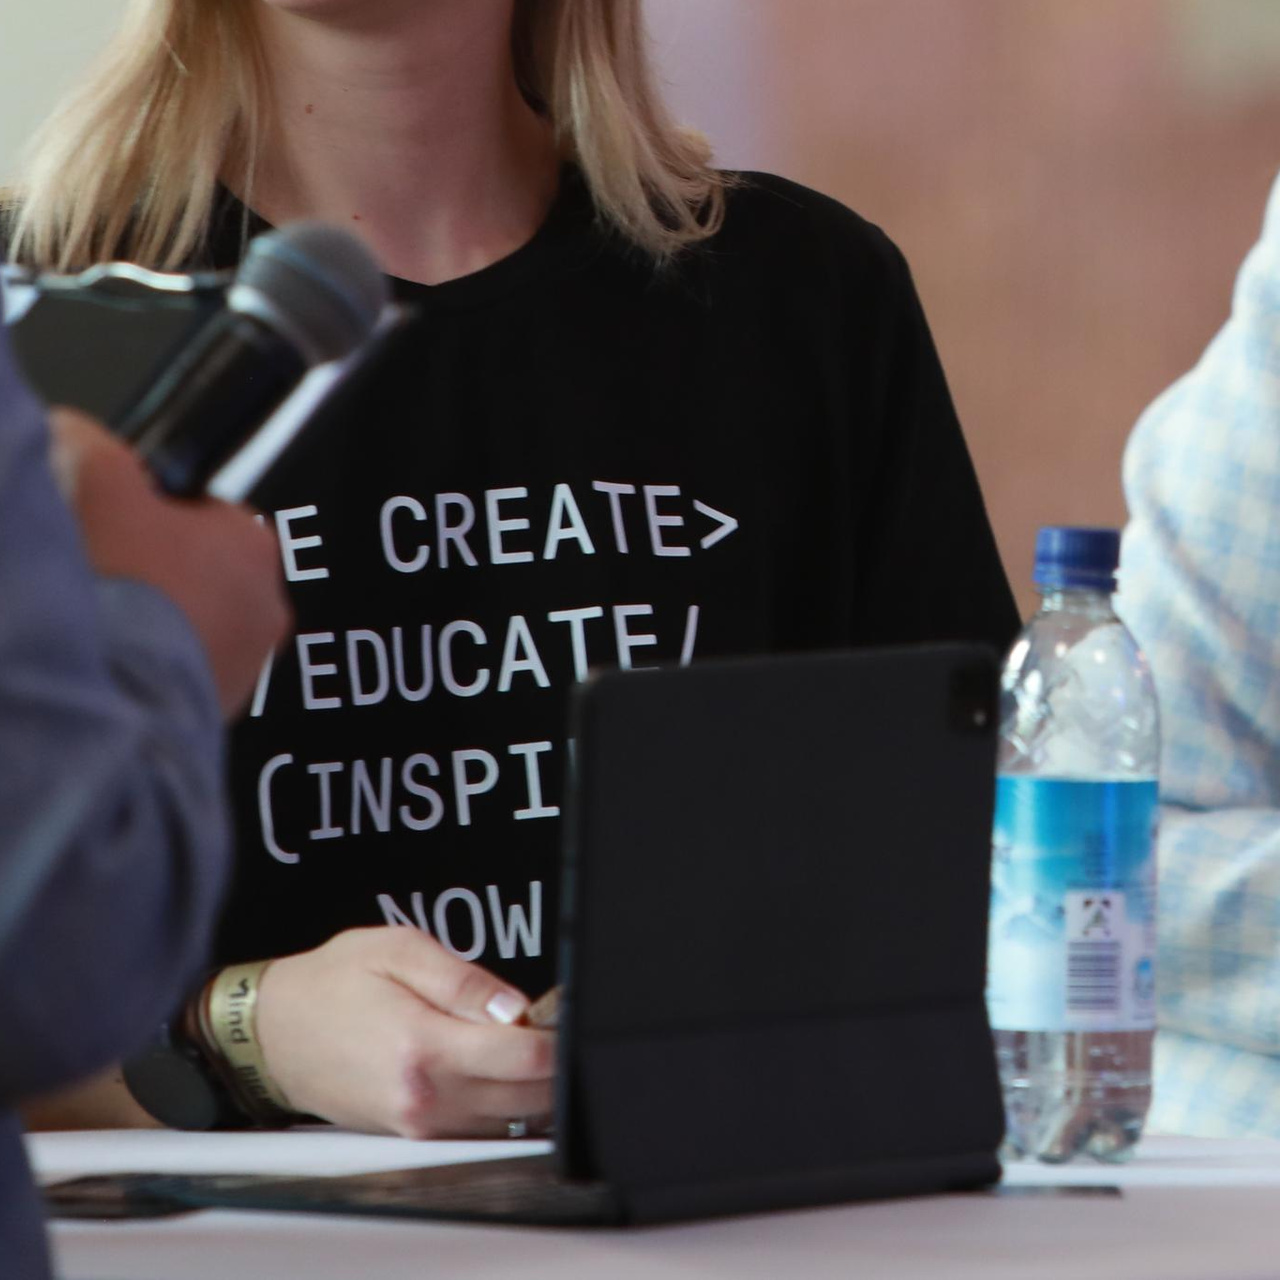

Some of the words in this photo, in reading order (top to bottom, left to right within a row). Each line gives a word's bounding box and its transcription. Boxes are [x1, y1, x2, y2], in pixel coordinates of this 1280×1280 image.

[256, 505, 328, 582] E
[379, 480, 738, 573] CREATE>
[257, 740, 577, 864] (INSPI
